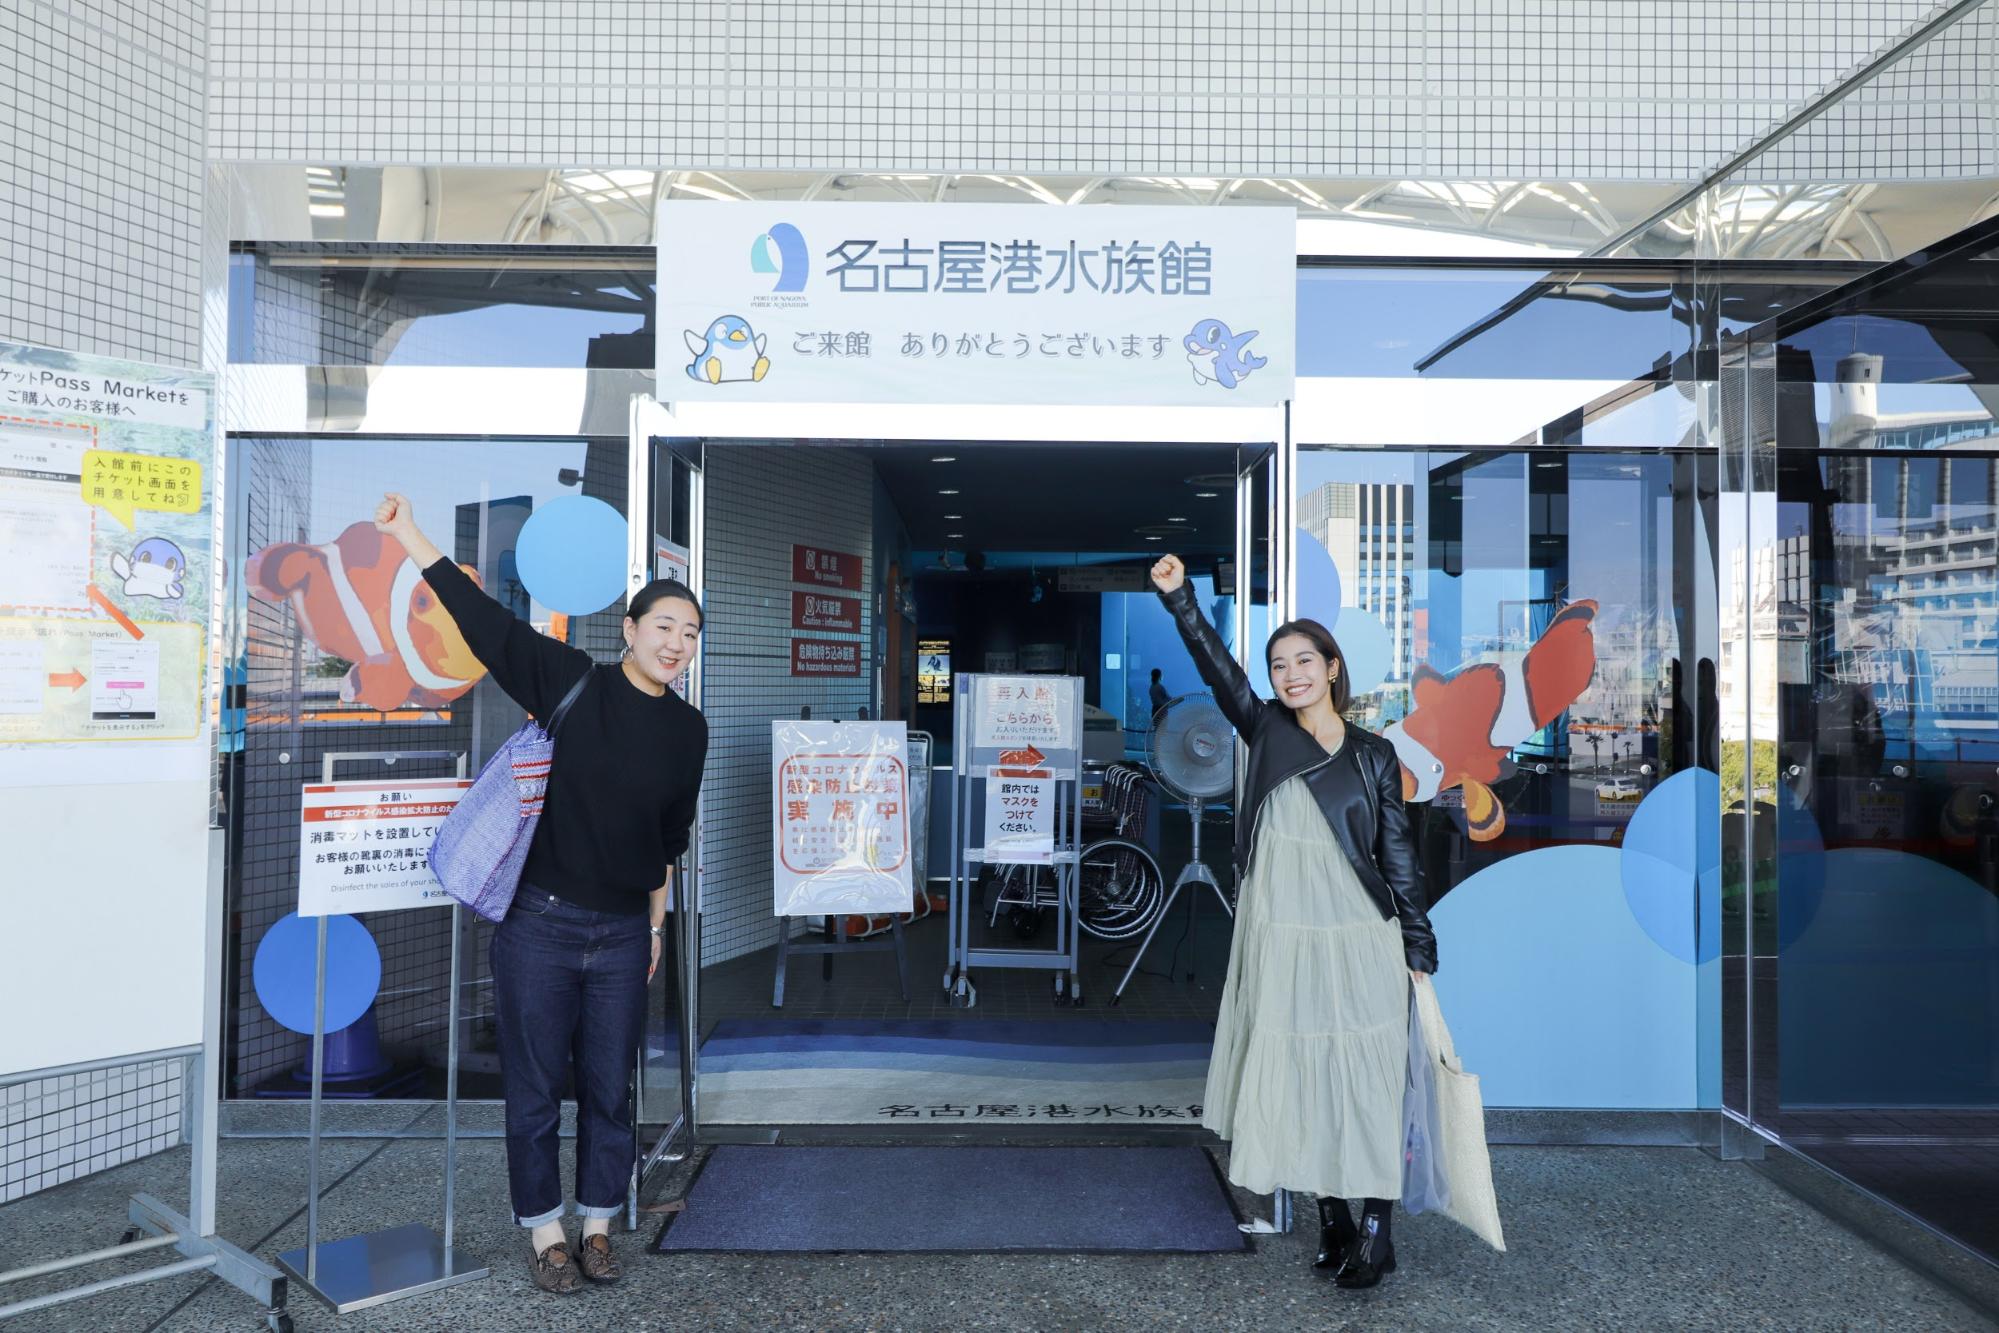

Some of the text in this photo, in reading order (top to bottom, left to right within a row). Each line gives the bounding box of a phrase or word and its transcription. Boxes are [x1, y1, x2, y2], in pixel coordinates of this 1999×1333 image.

[826, 238, 1211, 295] 名古屋港水族館
[792, 329, 1172, 359] ご来館 ありがとうございます
[7, 389, 137, 416] ご購入のお客様へ
[94, 457, 191, 476] 入館前にこの
[94, 472, 190, 491] チケット画面を
[815, 599, 842, 616] 火気厳禁
[797, 661, 856, 673] No hazardous materials
[997, 711, 1053, 725] こちらから
[1001, 783, 1040, 794] 館内では
[380, 793, 413, 802] お願い
[1001, 797, 1039, 807] マスクを
[1005, 810, 1034, 820] つけて
[999, 822, 1037, 833] ください。
[331, 883, 364, 892] Disinfect
[410, 879, 427, 888] your
